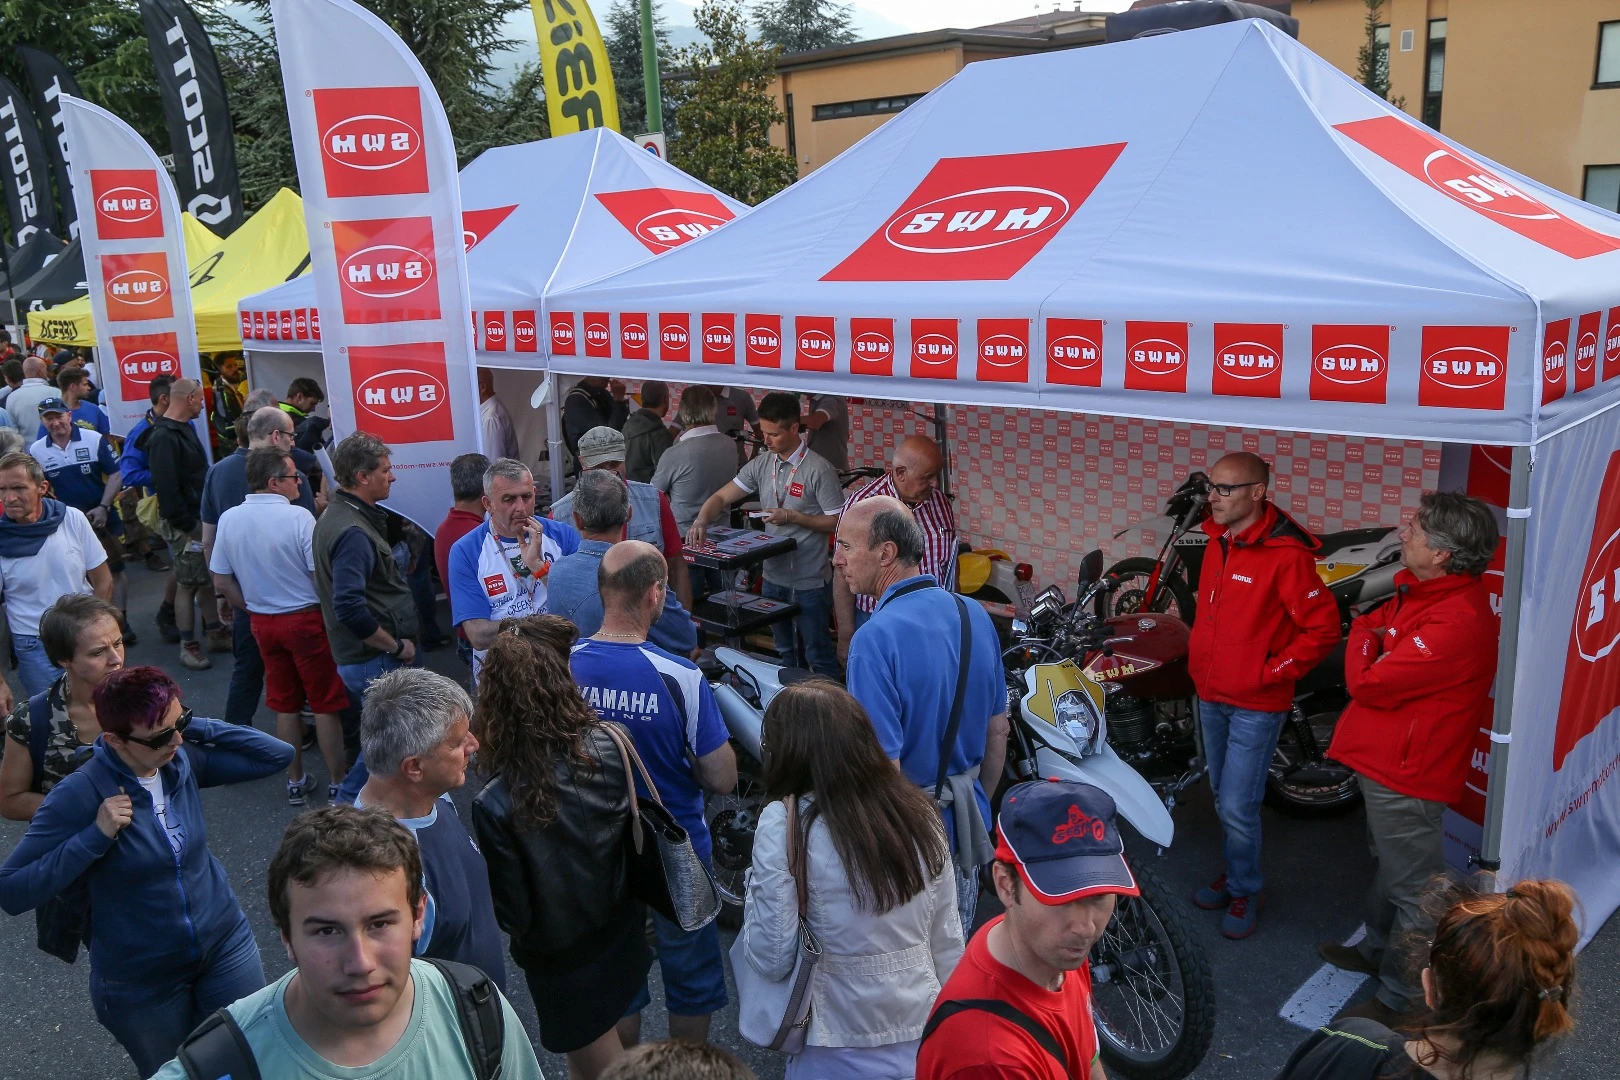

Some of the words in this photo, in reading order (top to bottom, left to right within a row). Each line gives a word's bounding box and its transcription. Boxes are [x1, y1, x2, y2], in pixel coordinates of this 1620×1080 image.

[1443, 174, 1538, 203] SW
[900, 206, 1053, 234] SWM
[647, 222, 721, 241] SW
[487, 327, 504, 336] SWM
[516, 327, 534, 336] SWM
[554, 329, 573, 339] SWM
[587, 331, 608, 340] SWM
[624, 332, 645, 341] SWM
[663, 332, 687, 343] SWM
[706, 334, 731, 344] SWM
[750, 335, 778, 347] SWM
[801, 339, 831, 350] SWM
[857, 342, 889, 353] SWM
[918, 343, 953, 355] SWM
[984, 345, 1022, 357] SWM
[1054, 346, 1096, 360] SWM
[1577, 343, 1595, 361] SWM
[1134, 350, 1180, 364] SWM
[1223, 353, 1274, 368] SWM
[1545, 353, 1564, 372] SWM
[1322, 357, 1379, 372] SWM
[1432, 359, 1496, 376] SWM
[1094, 663, 1135, 681] SWM
[577, 686, 659, 714] YAMAHA
[594, 709, 652, 721] CING
